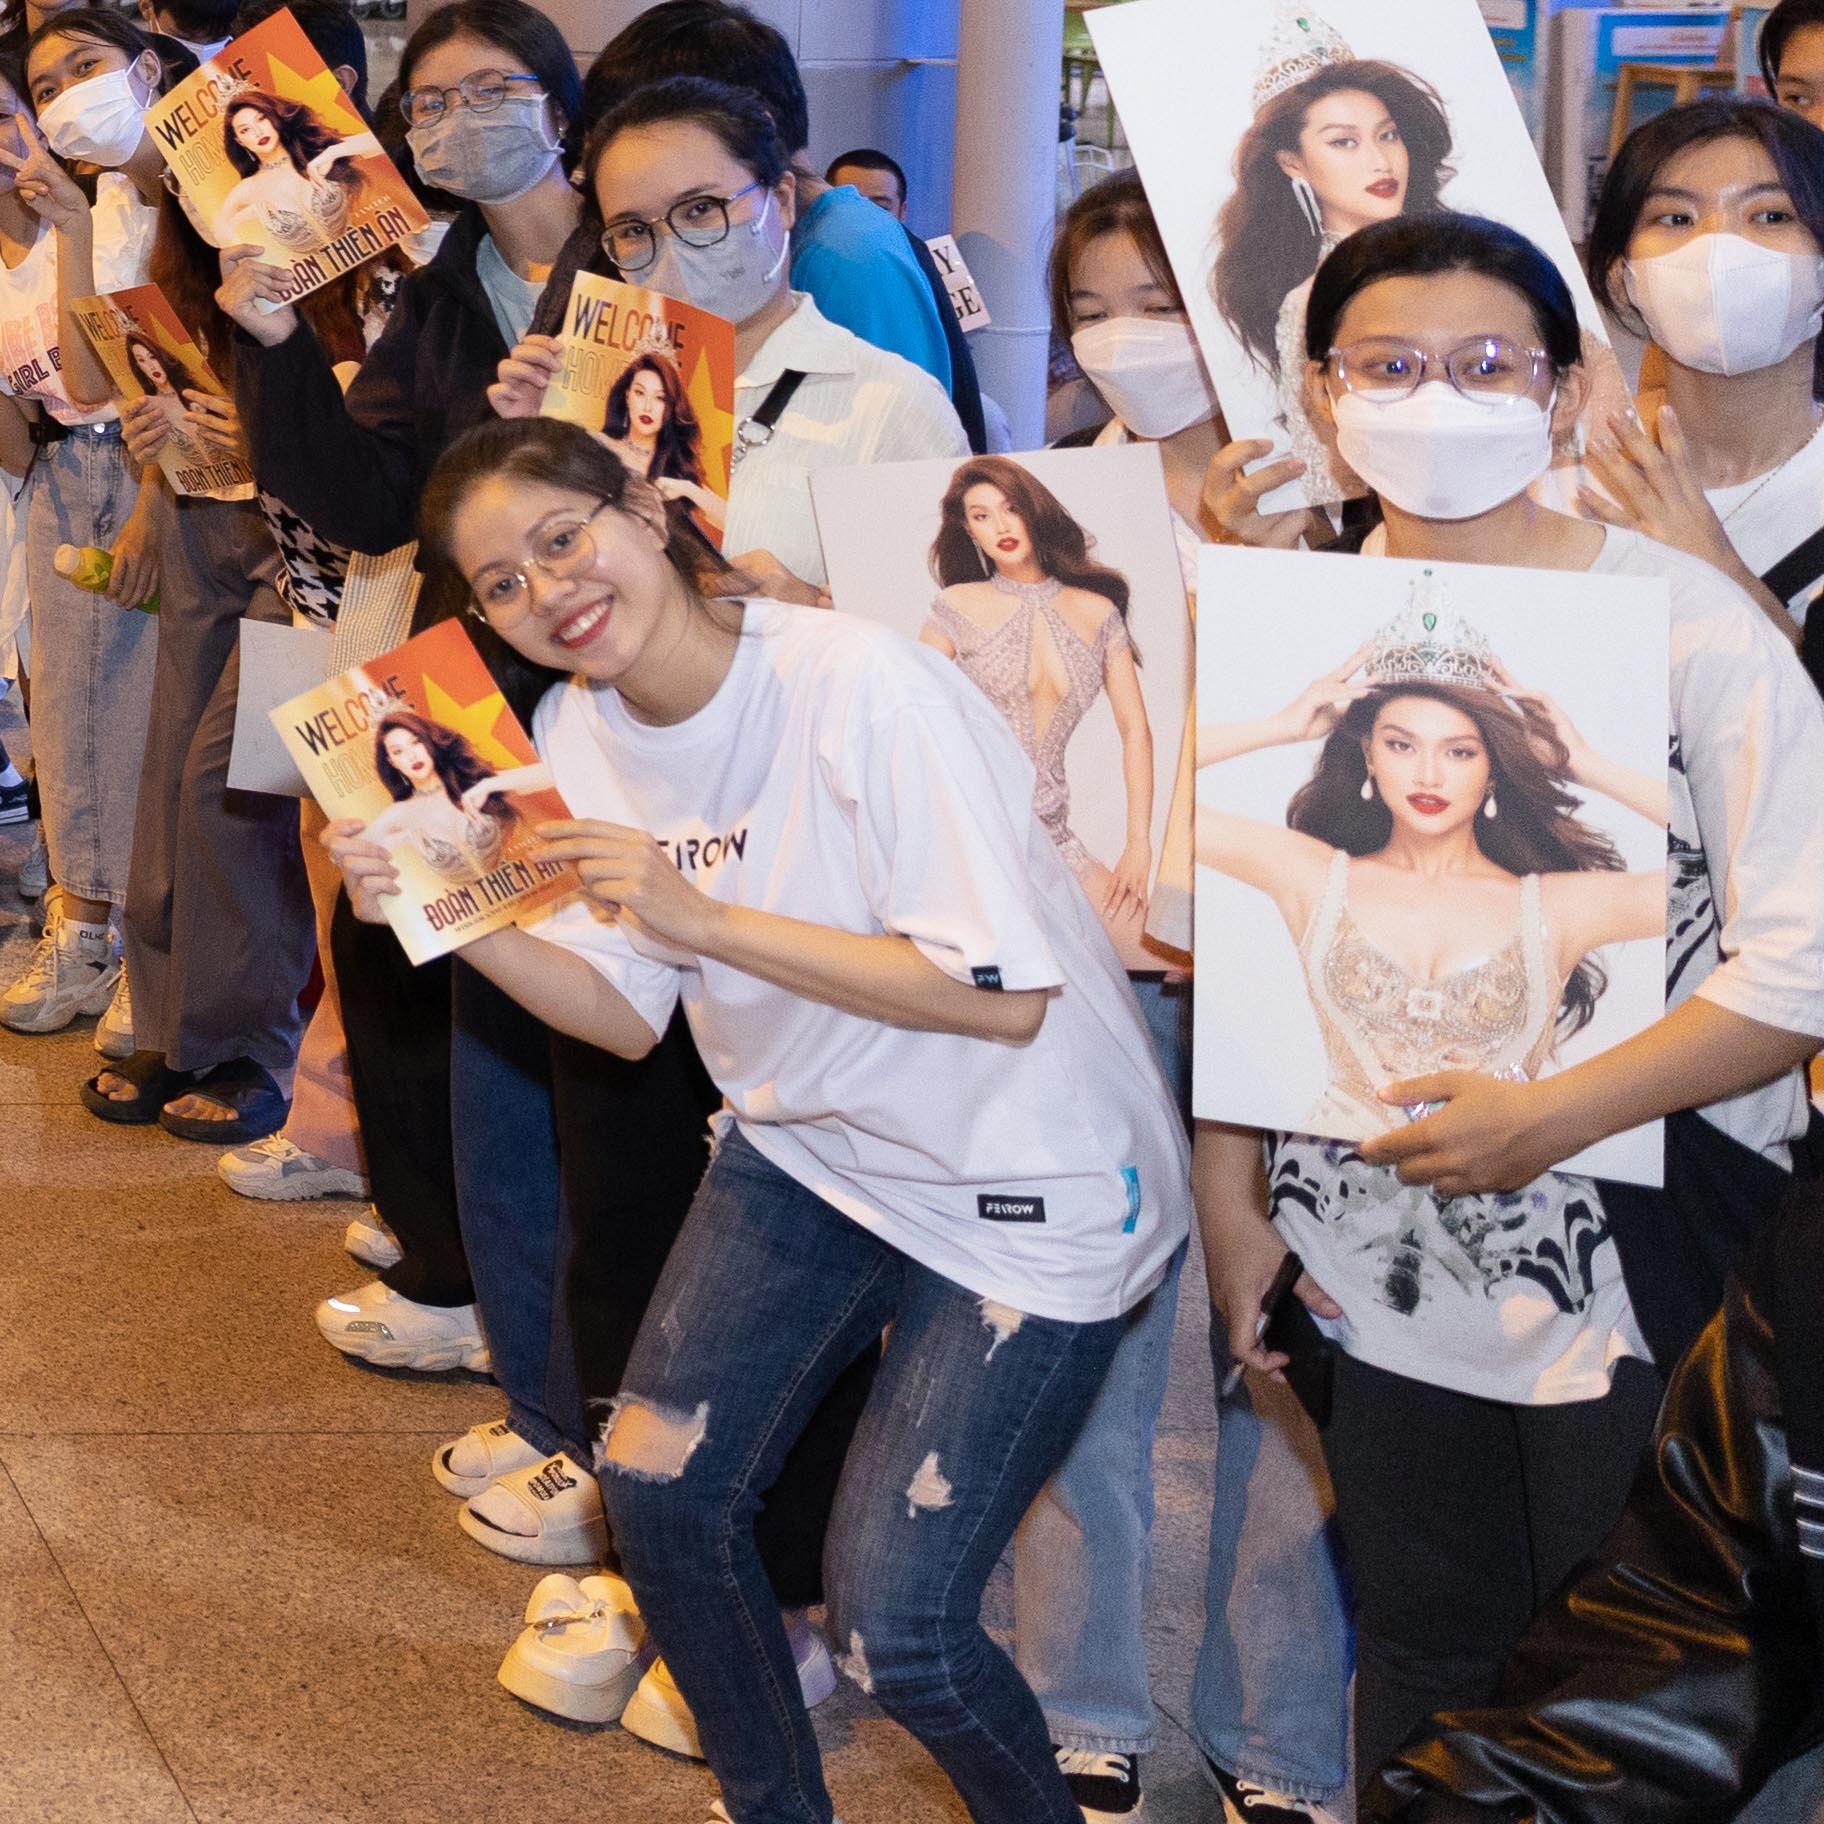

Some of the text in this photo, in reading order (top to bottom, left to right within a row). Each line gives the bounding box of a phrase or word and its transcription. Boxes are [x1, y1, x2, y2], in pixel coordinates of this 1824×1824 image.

[319, 226, 379, 273] THIÊN
[378, 206, 412, 246] ÂN
[7, 358, 50, 395] GIRL
[423, 886, 480, 933] ĐOÀN
[474, 856, 536, 903] THIÊN
